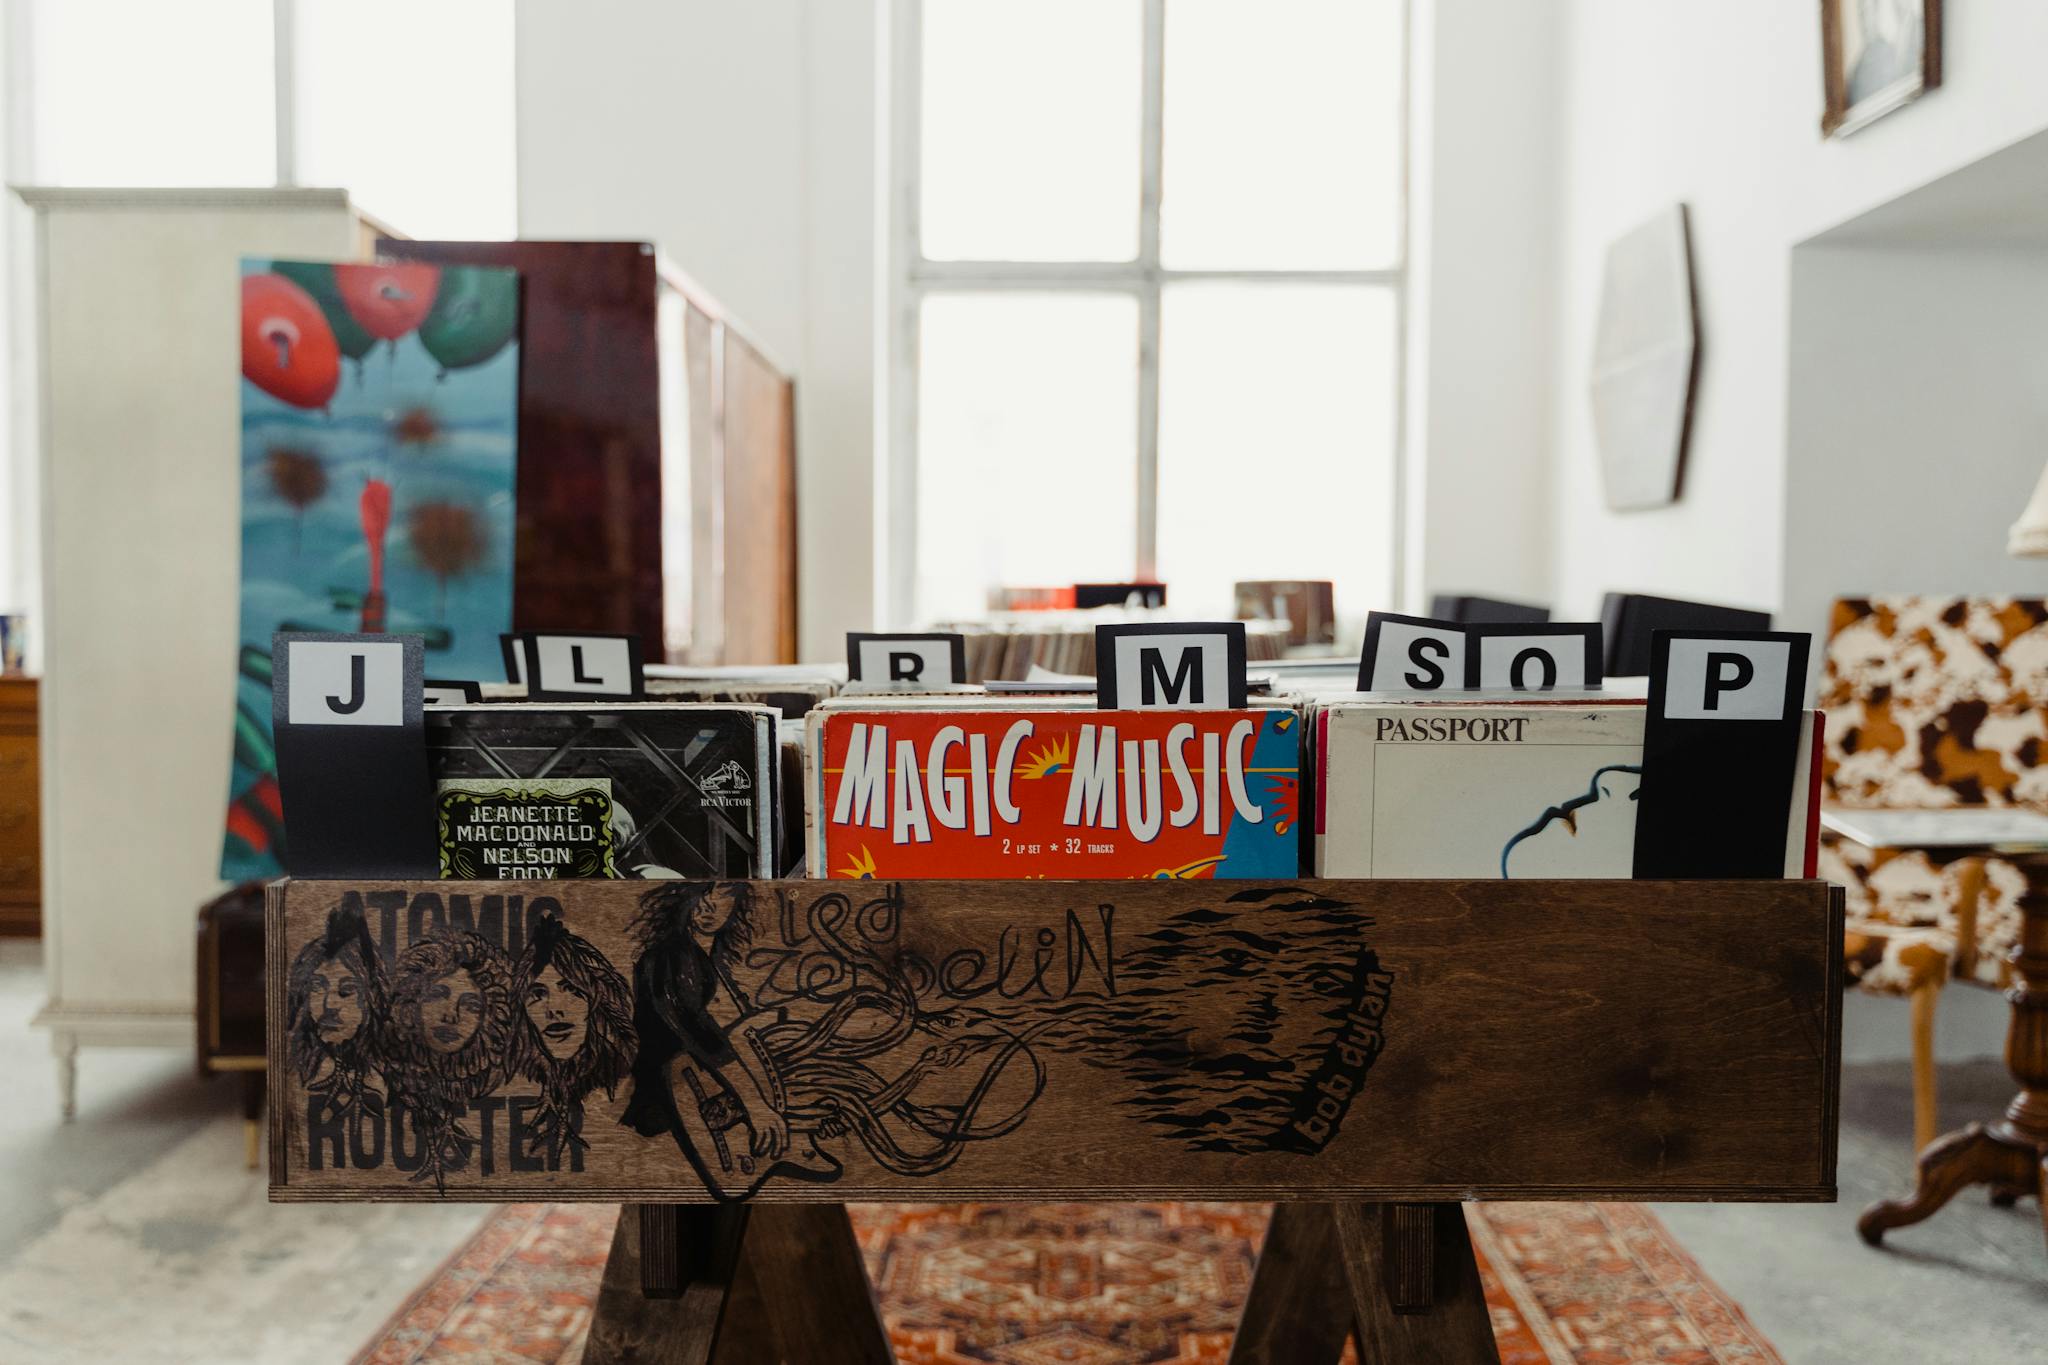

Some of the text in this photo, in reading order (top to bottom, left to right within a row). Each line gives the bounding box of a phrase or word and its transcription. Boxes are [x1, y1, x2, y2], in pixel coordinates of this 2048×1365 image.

[571, 645, 603, 685] L
[889, 651, 925, 682] R
[1140, 646, 1204, 705] M
[1404, 637, 1450, 691] S
[1510, 647, 1557, 691] O
[1703, 652, 1754, 710] P
[326, 655, 366, 715] J
[1375, 717, 1529, 742] PASSPORT
[832, 719, 1262, 844] MAGIC MUSIC
[470, 806, 581, 823] JEANETTE
[700, 796, 752, 808] RCA VICTOR
[457, 825, 594, 842] MACDONALD
[1002, 838, 1115, 854] 2 LP SET 32 TRACKS
[483, 847, 571, 865] NELSON
[307, 1093, 586, 1177] ROOSTER
